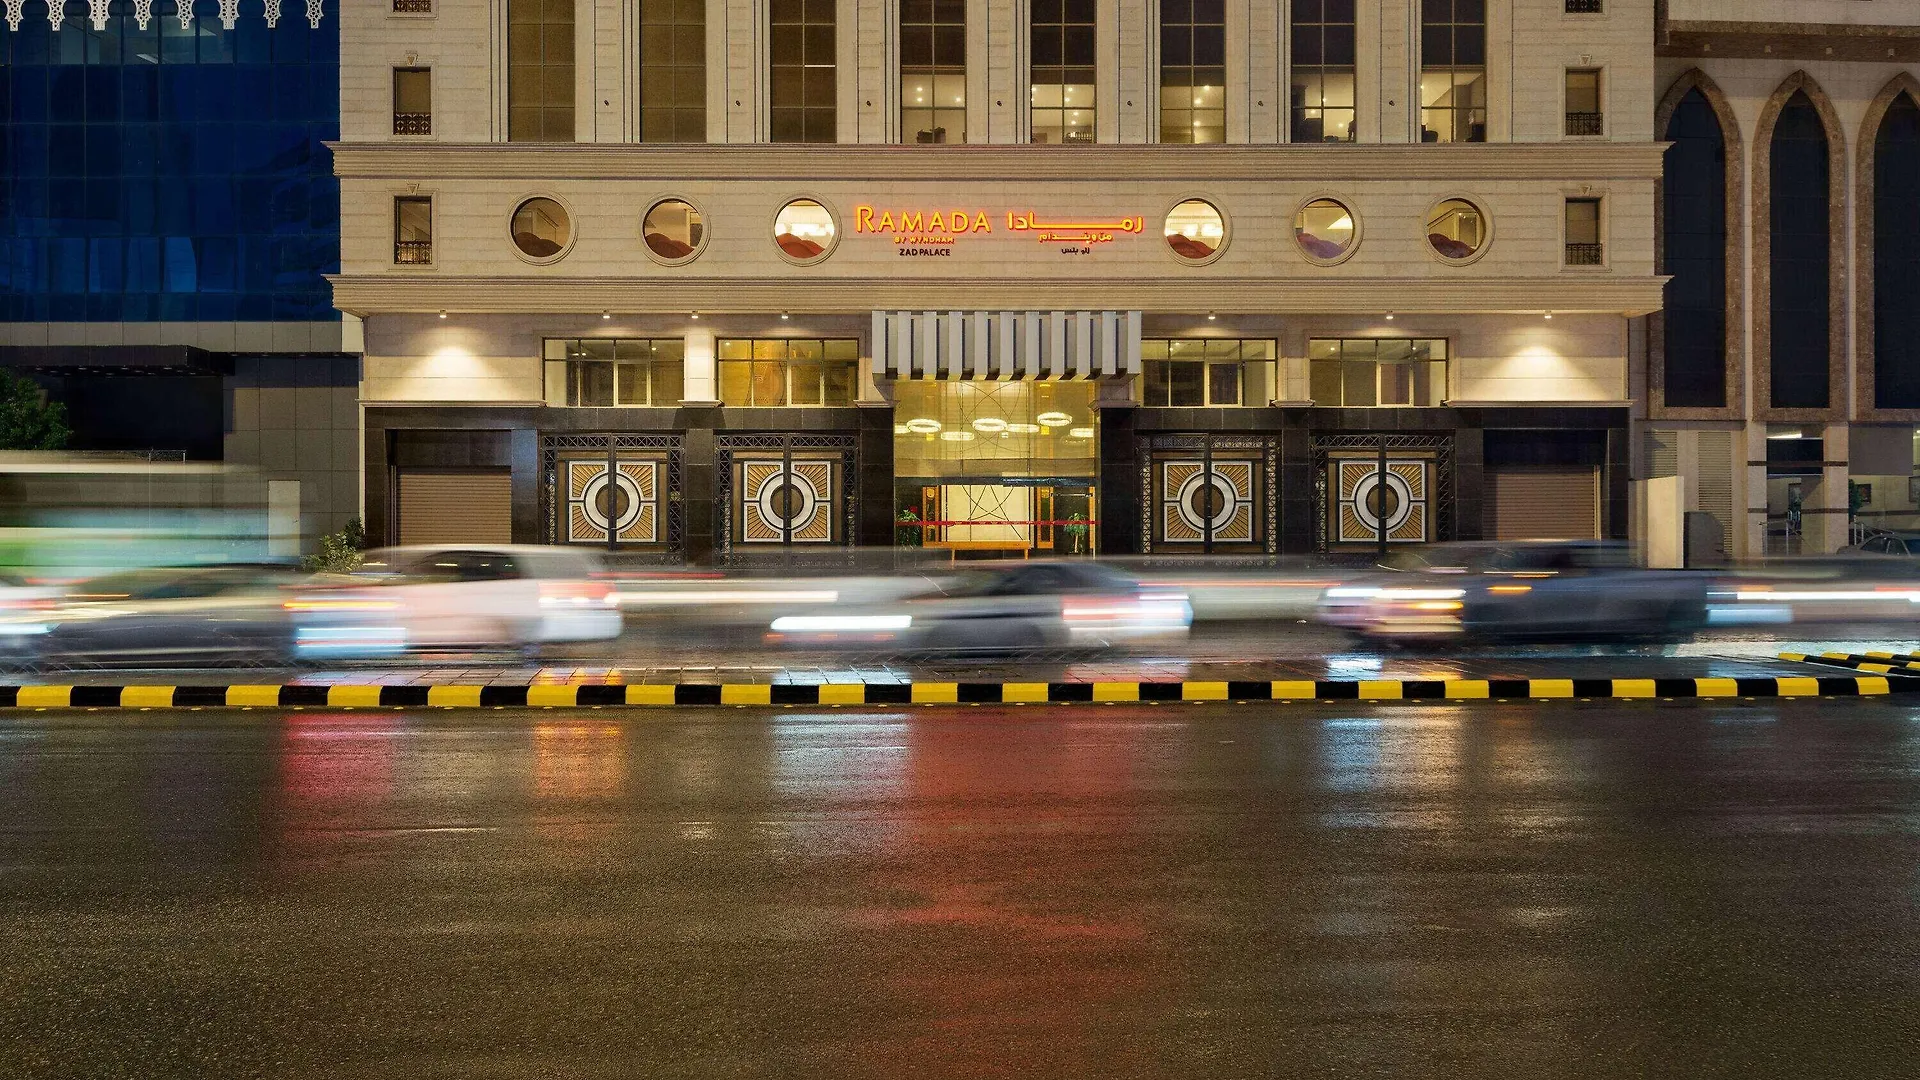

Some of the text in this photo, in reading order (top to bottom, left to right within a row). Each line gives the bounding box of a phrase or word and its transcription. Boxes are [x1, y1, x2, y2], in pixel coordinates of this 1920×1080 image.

[856, 205, 992, 233] RAMADA
[1007, 211, 1143, 234] رمادا
[893, 236, 955, 244] BY WYNDHAM
[1098, 231, 1114, 242] من
[899, 248, 951, 256] ZAD PALACE
